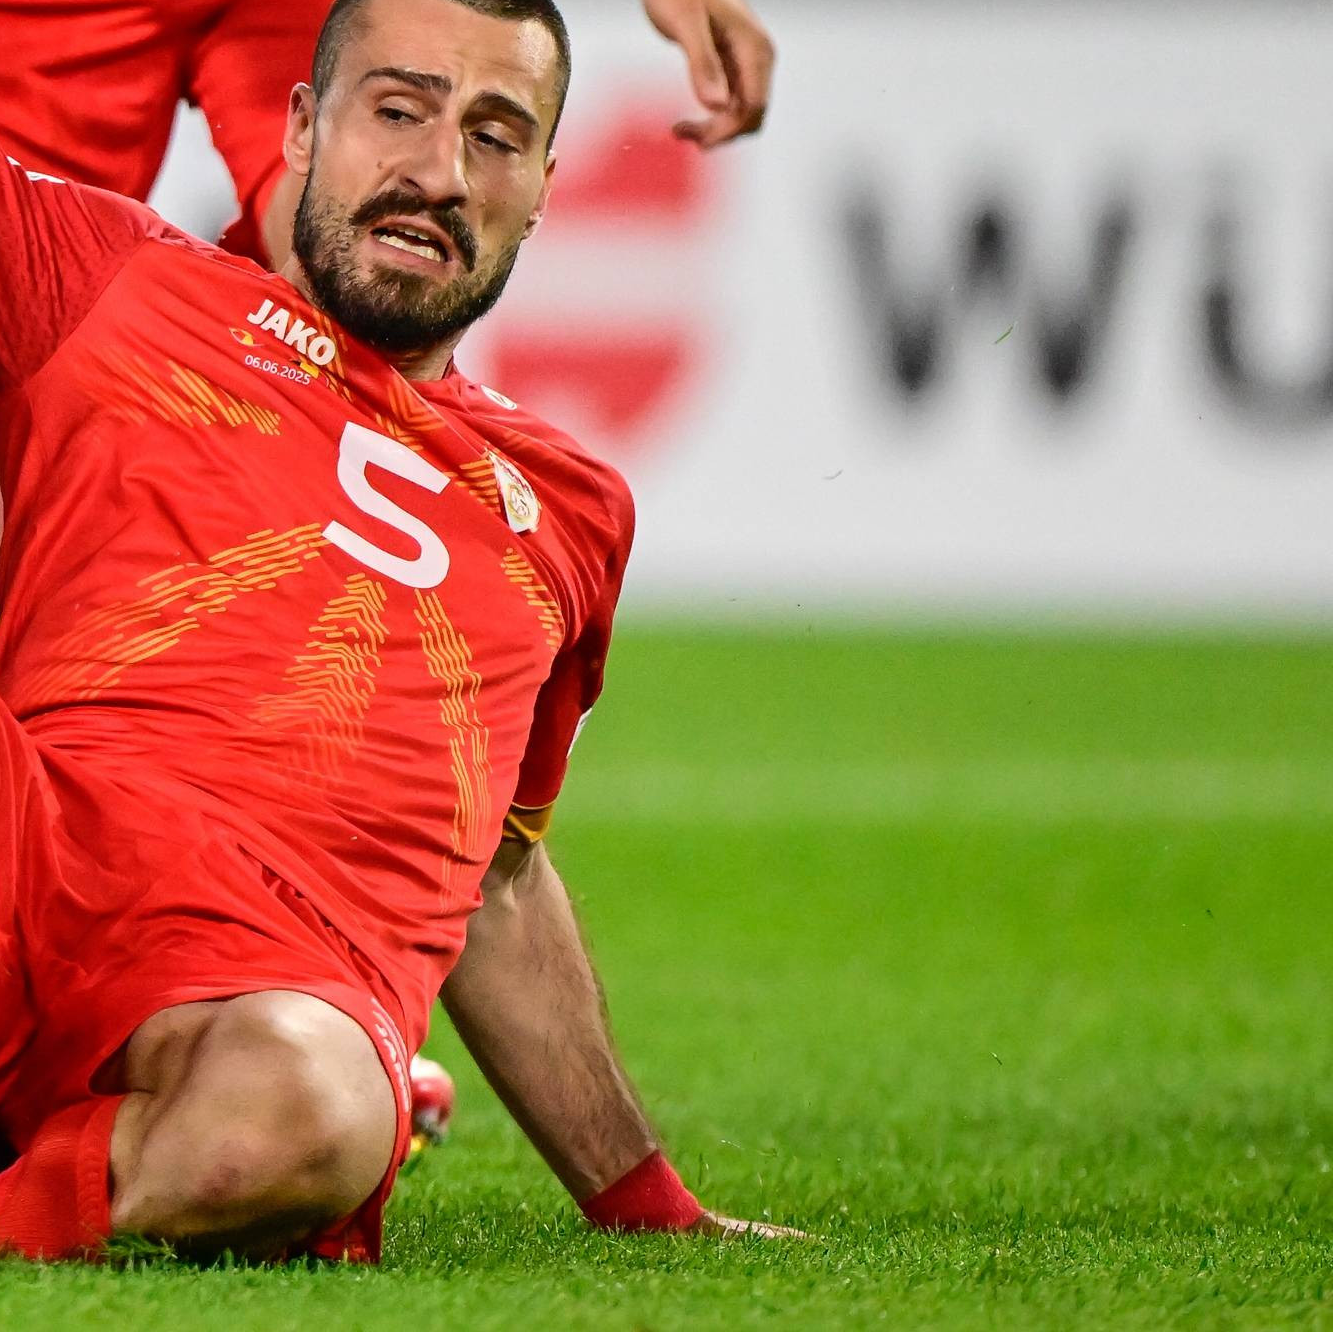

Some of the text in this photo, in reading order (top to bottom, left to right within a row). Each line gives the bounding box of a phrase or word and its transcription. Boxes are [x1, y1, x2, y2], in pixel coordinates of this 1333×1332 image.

[246, 298, 337, 366] JAKO
[244, 354, 312, 386] 06.06.2025
[321, 420, 452, 589] 5
